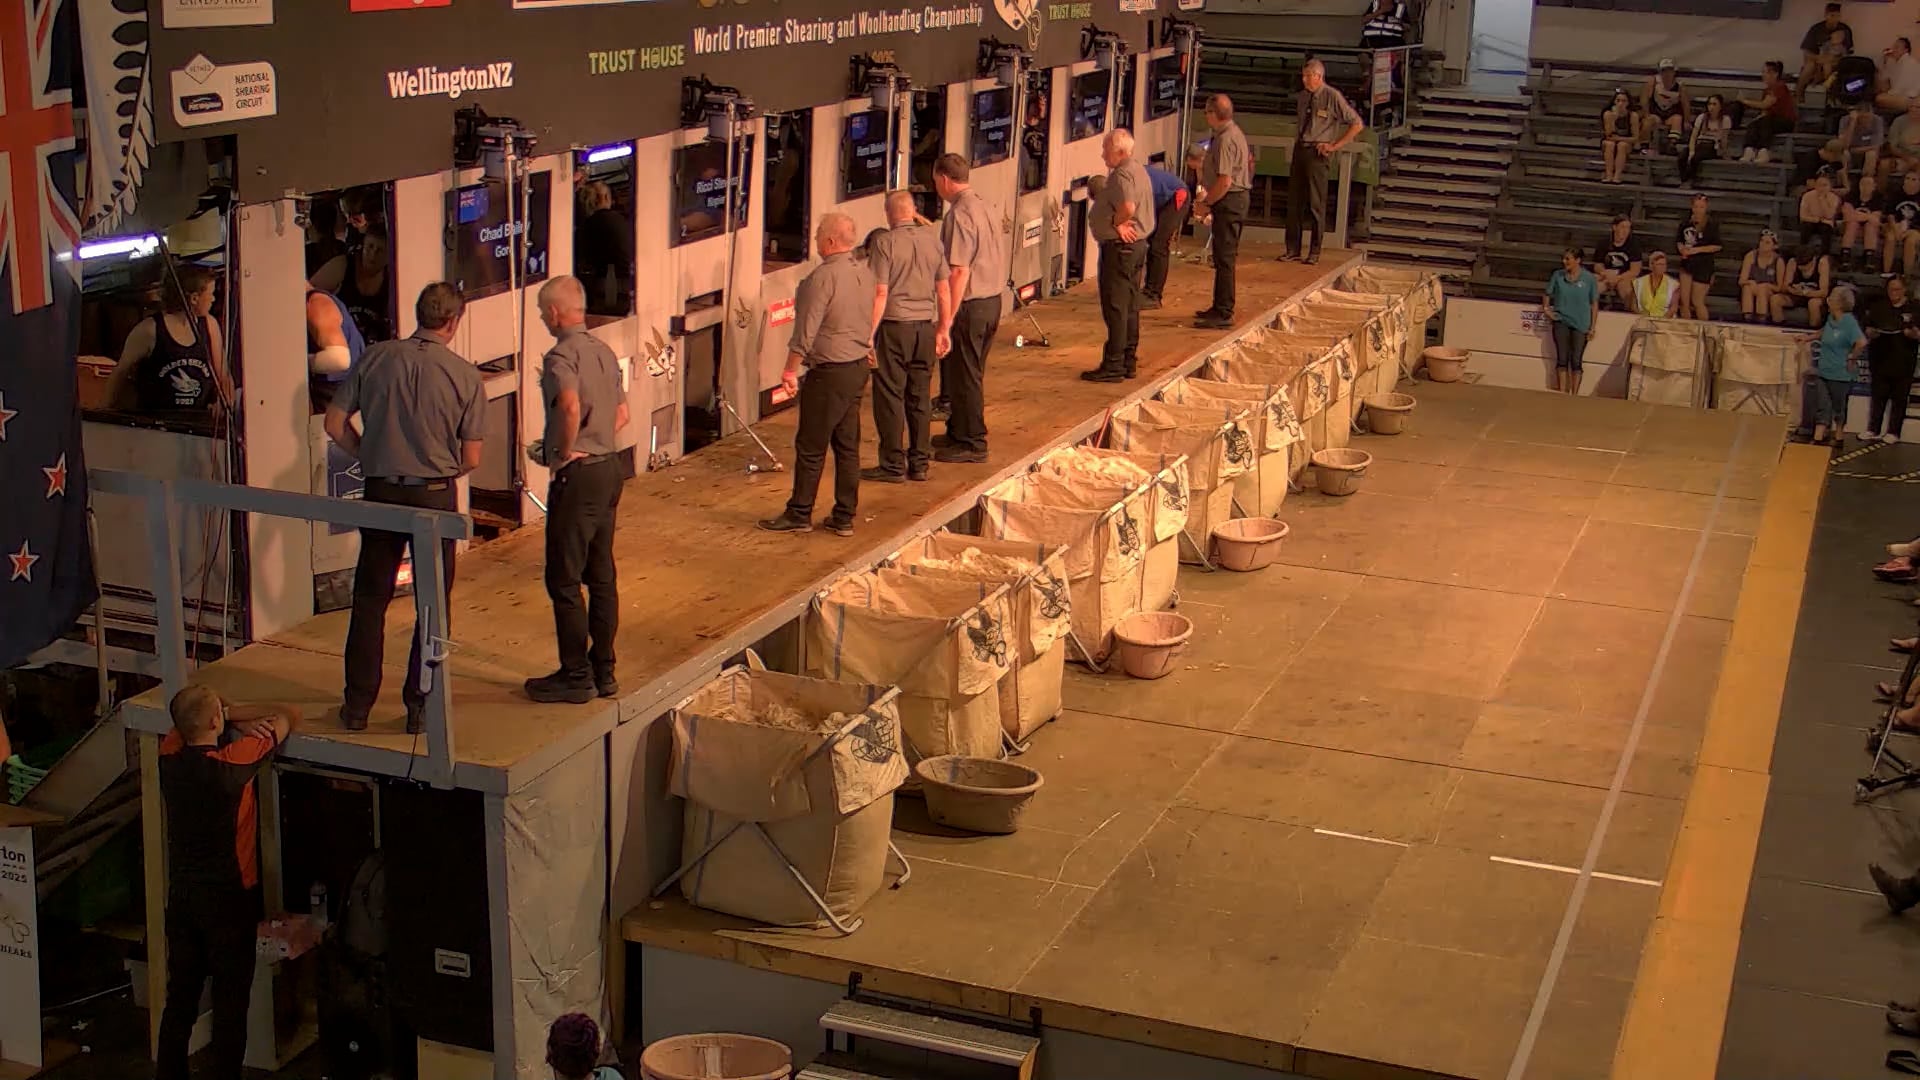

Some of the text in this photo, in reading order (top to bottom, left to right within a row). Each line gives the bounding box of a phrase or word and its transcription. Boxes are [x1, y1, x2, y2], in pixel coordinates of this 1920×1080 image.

[1049, 3, 1091, 20] TRUST HOUSE
[694, 3, 983, 54] World Premier Shearing and Woolhandling Championship
[588, 45, 685, 75] TRUST HOUSE
[234, 73, 270, 84] NATIONAL
[387, 62, 513, 99] WellingtonNZ
[235, 84, 271, 97] SHEARING
[236, 97, 262, 109] CIRCUIT
[480, 224, 503, 242] Chad
[0, 944, 33, 959] HEARS
